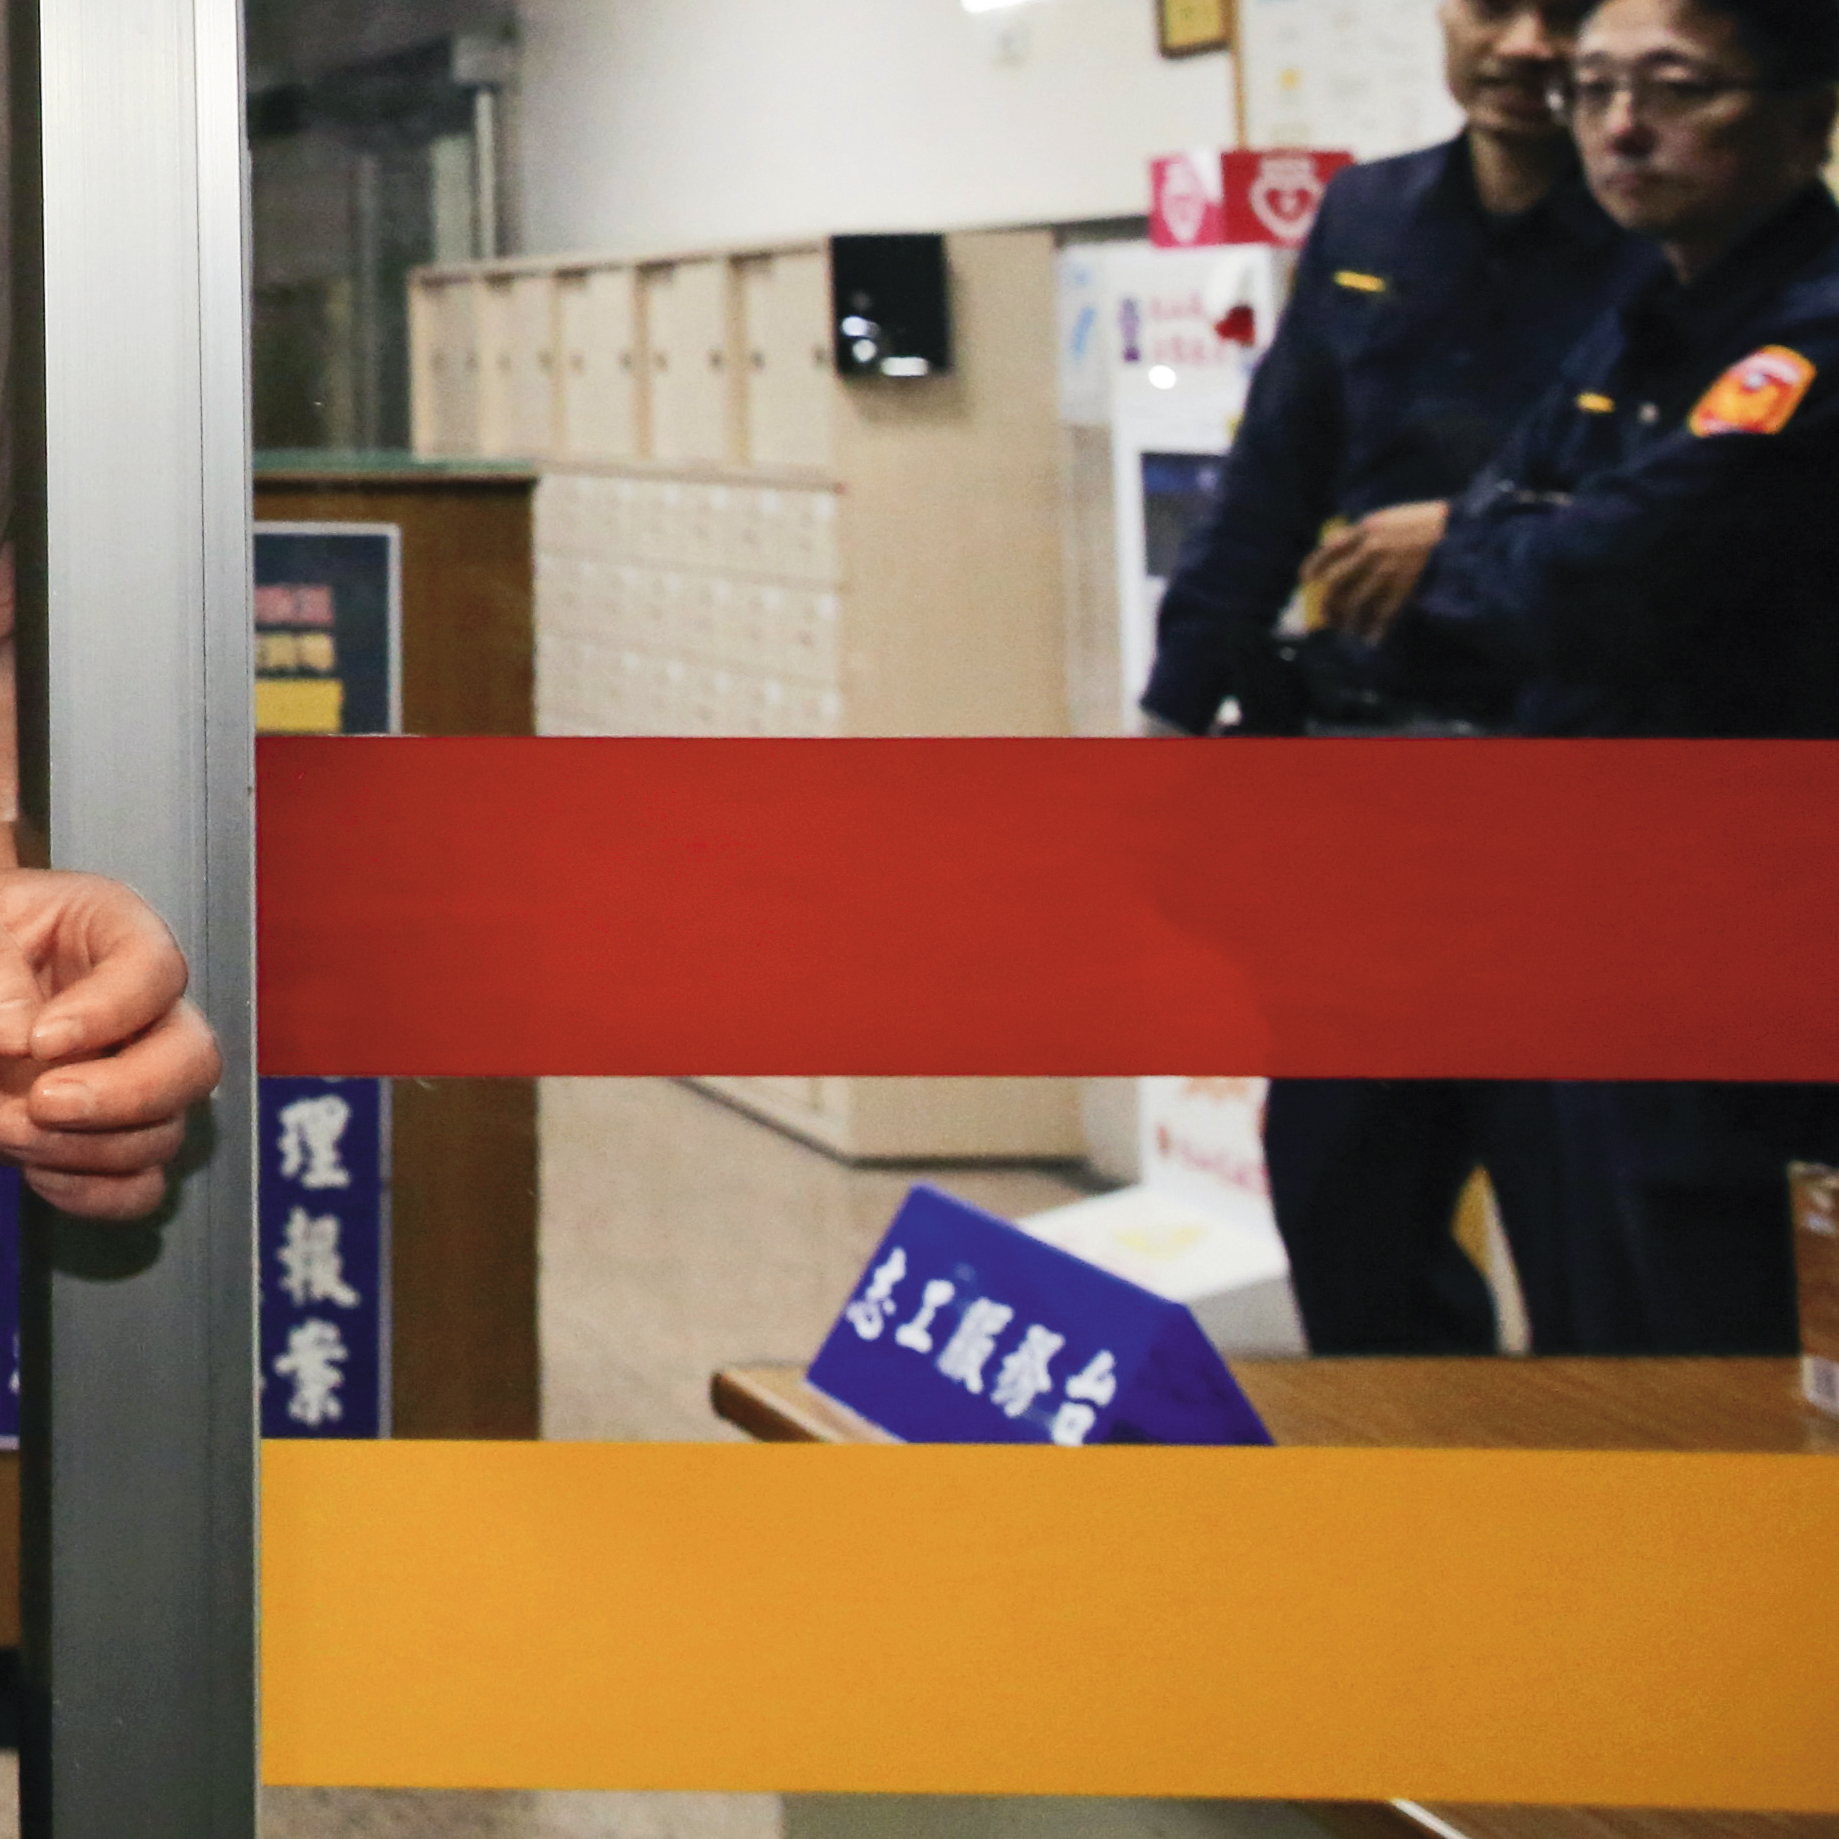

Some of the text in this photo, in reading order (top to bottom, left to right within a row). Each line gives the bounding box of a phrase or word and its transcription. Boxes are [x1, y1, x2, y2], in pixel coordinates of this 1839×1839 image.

[846, 1246, 1118, 1447] 志工服務台
